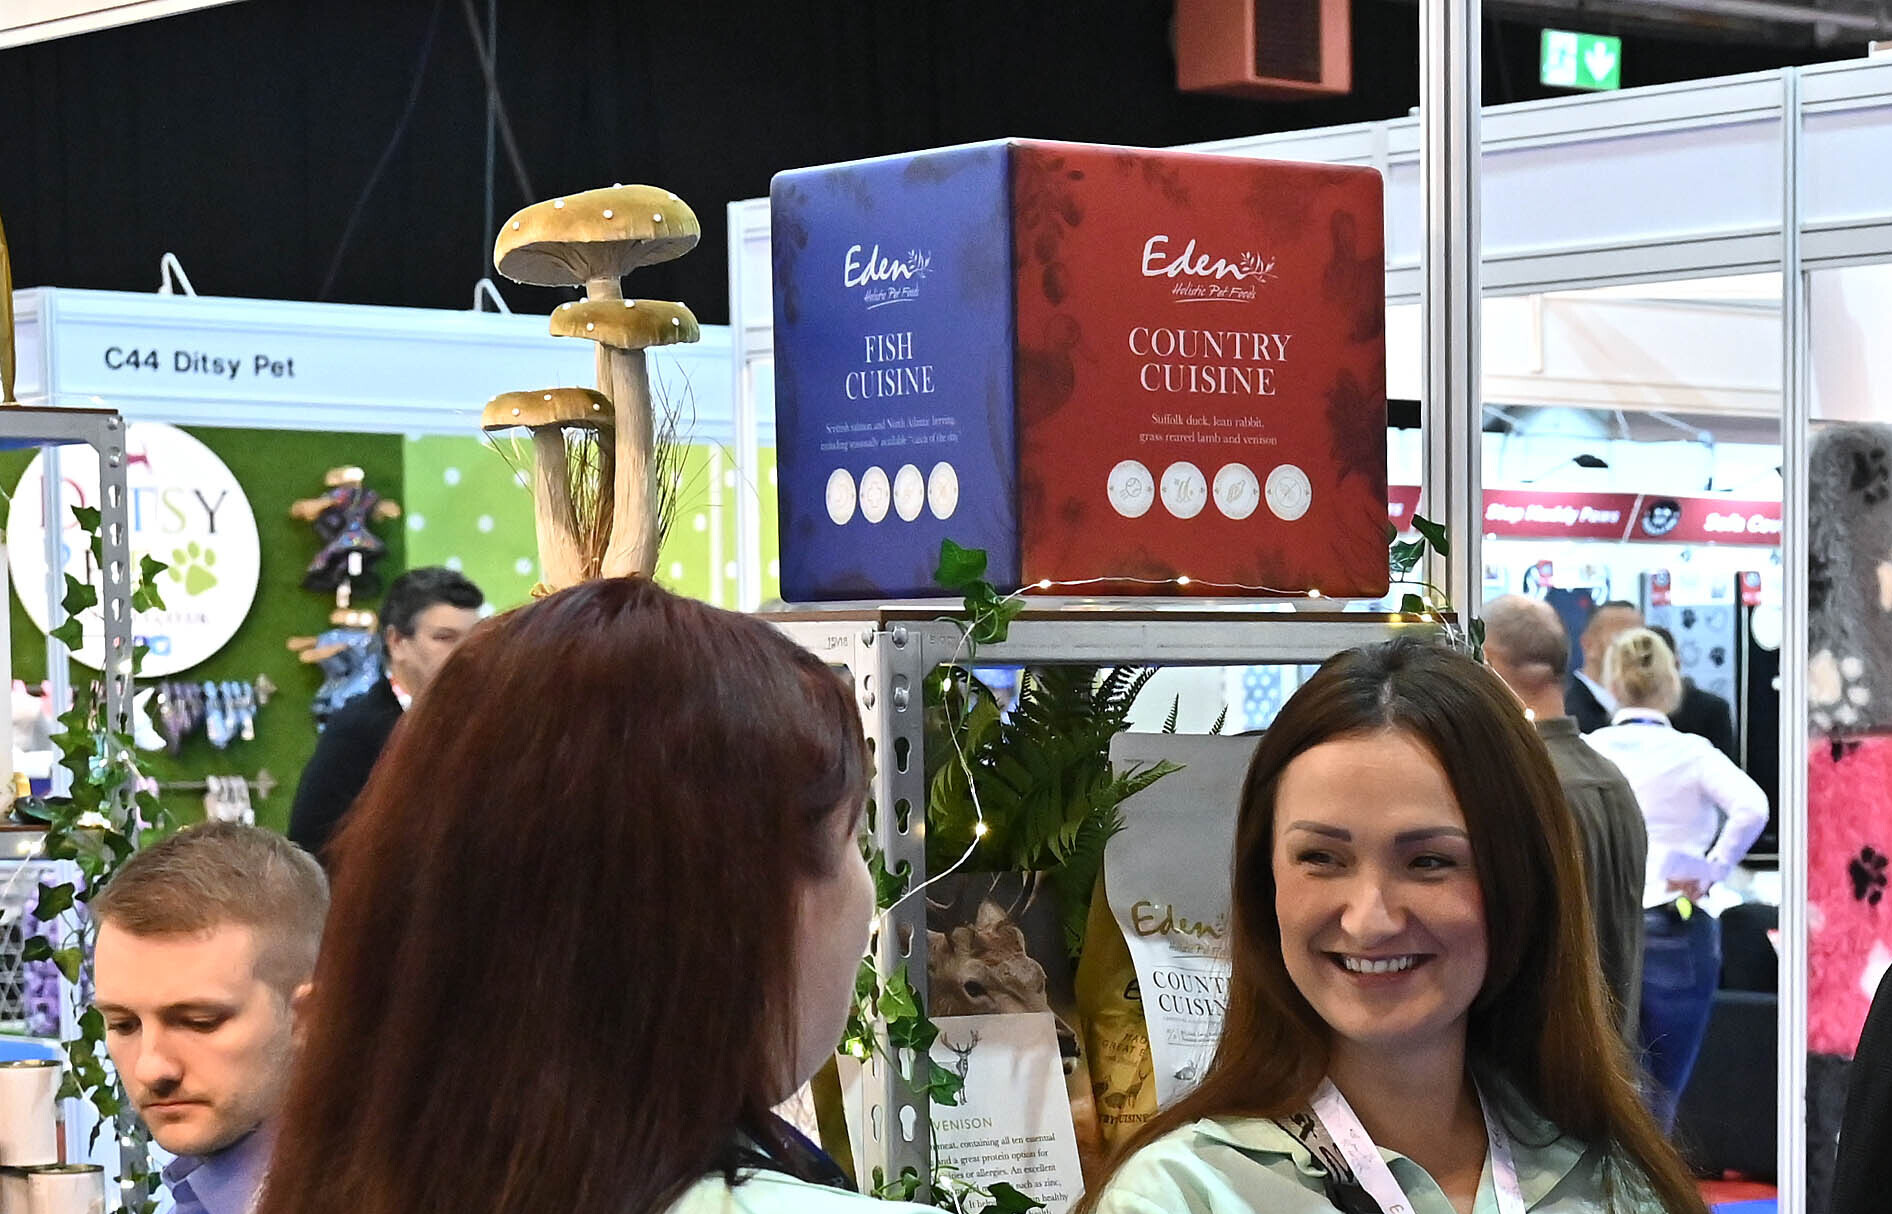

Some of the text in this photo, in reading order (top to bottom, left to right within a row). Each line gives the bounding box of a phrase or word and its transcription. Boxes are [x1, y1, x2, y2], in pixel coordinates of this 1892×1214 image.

[844, 244, 912, 288] Eden
[1141, 234, 1248, 280] Eden
[1172, 282, 1256, 300] Holistic Pet Foods
[864, 331, 913, 363] FISH
[1128, 326, 1293, 362] COUNTRY
[105, 347, 296, 380] C44 Ditsy Pet
[845, 365, 936, 400] CUISINE
[1140, 362, 1277, 396] CUISINE
[1151, 413, 1184, 426] Suffolk
[1213, 415, 1233, 428] lean
[1166, 431, 1195, 444] reared
[1198, 431, 1221, 444] lamb
[1223, 432, 1241, 445] and
[1243, 434, 1278, 447] venison
[40, 475, 228, 534] DTSY
[1131, 901, 1223, 940] Eden
[1152, 970, 1227, 995] COUNT
[1158, 993, 1226, 1016] CUISIN
[933, 1117, 993, 1132] VENISON
[1001, 1136, 1010, 1145] all
[981, 1152, 1010, 1165] protein
[1037, 1149, 1049, 1157] for
[1010, 1165, 1023, 1175] An
[1042, 1191, 1069, 1203] healthy
